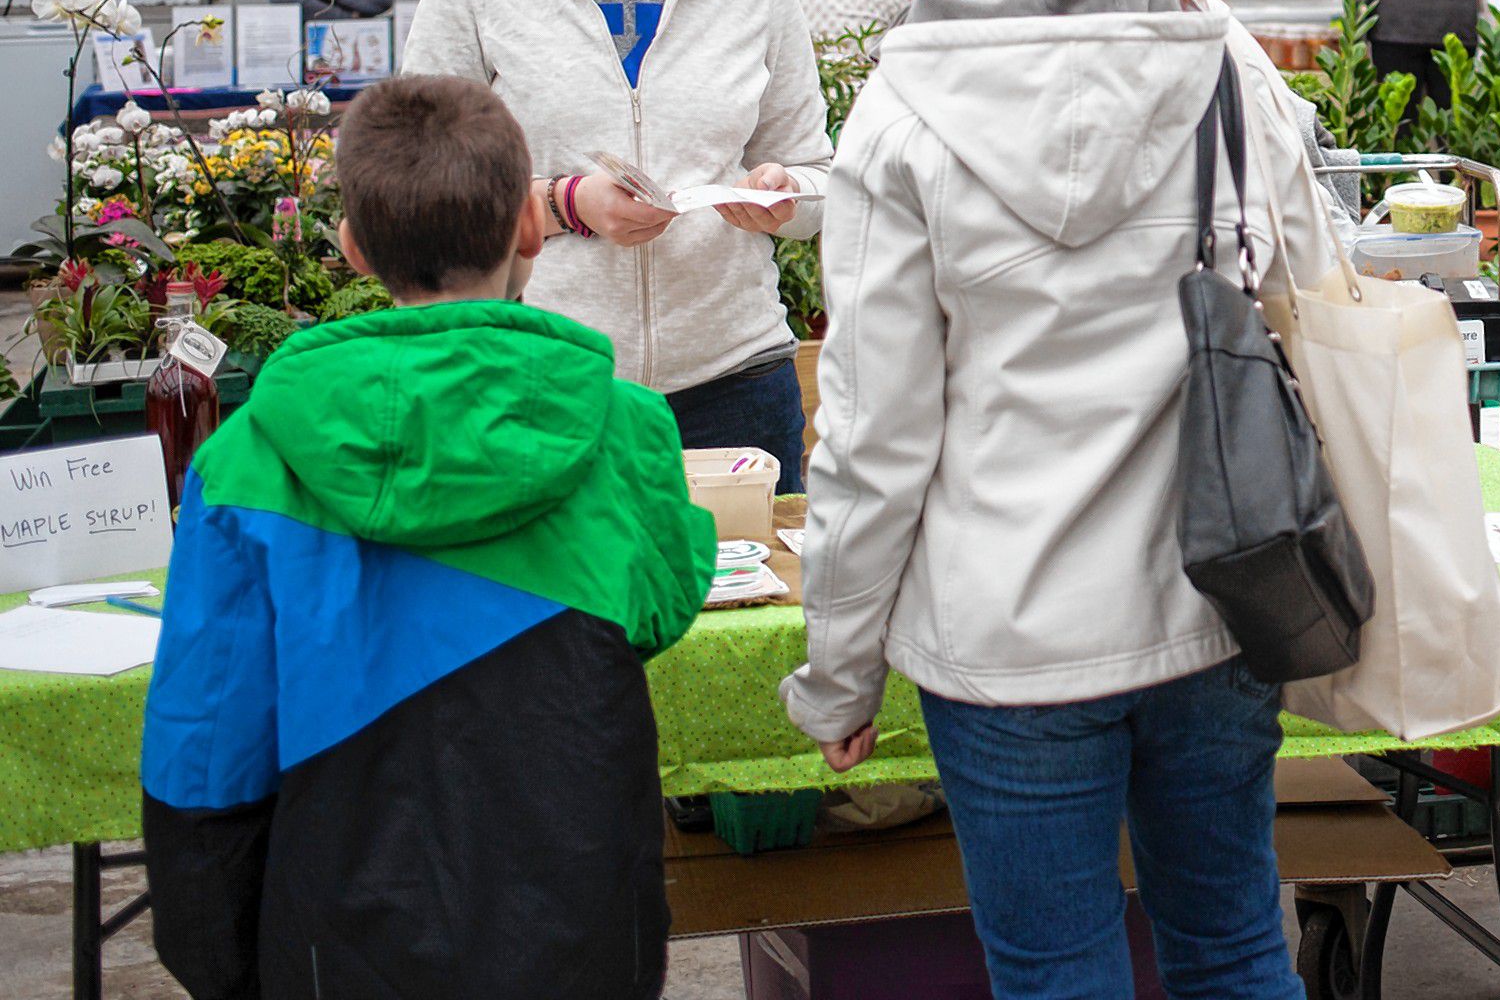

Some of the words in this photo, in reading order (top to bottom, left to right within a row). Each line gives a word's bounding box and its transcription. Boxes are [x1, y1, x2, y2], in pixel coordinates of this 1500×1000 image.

[10, 467, 52, 494] Win
[66, 456, 114, 481] Free
[1, 512, 71, 541] MAPLE
[86, 500, 156, 529] SYRUP!
